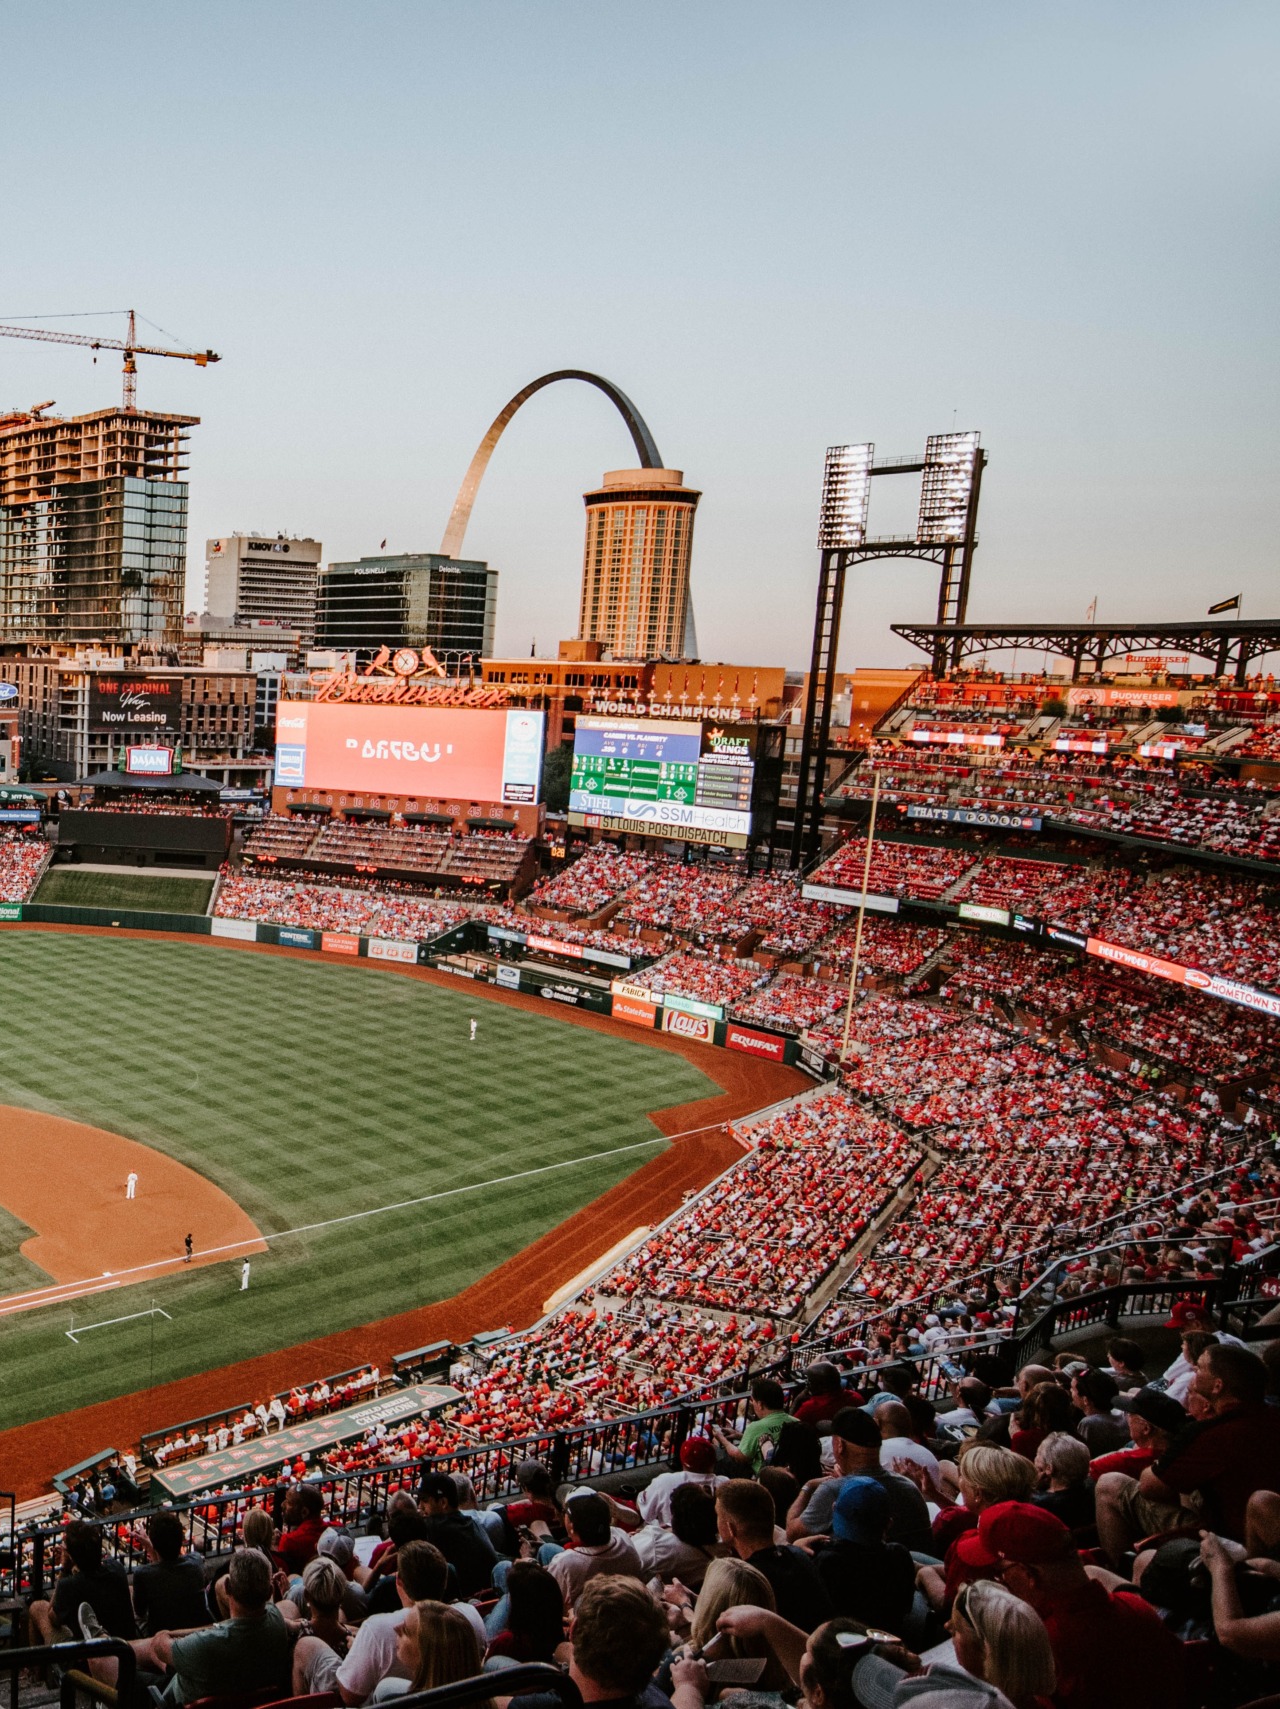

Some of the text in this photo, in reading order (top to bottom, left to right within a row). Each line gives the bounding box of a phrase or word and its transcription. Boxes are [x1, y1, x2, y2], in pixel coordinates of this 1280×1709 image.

[248, 542, 281, 552] KMOV 4
[354, 567, 386, 575] POLSINELLI
[1126, 654, 1189, 663] BUDWEISER
[99, 682, 171, 694] ONE CARDINAL
[308, 671, 509, 706] Budweiser
[119, 689, 151, 710] Way
[1110, 690, 1172, 701] BUDWEISER
[595, 700, 742, 720] WORLD CHAMPIONS
[102, 711, 166, 724] Now Leasing
[710, 736, 750, 746] DRAFT
[714, 745, 748, 754] KINGS
[132, 754, 166, 766] DASANI
[312, 795, 320, 804] 2
[354, 796, 364, 807] 10
[370, 797, 380, 808] 14
[405, 801, 418, 812] 20
[426, 802, 438, 814] 24
[447, 803, 460, 816] 42
[468, 806, 482, 818] 45
[490, 807, 504, 819] 85
[580, 795, 613, 810] STIFEL
[913, 806, 950, 820] THAT'S
[952, 810, 961, 821] A
[602, 818, 616, 829] ST.
[618, 819, 645, 833] LOUIS
[648, 822, 728, 845] POST-DISPATCH
[1098, 944, 1150, 968] HOLLYWOOD
[437, 964, 474, 978] BUSCH STADIUM
[502, 968, 517, 978] Ford
[554, 992, 578, 1004] MIDWEST
[622, 986, 646, 998] FABICK
[1210, 982, 1270, 1010] HOMETOWN
[670, 1010, 708, 1036] Lay's
[730, 1032, 778, 1053] EQUIFAX
[1262, 1282, 1280, 1297] 44
[348, 1406, 382, 1420] WORLD
[355, 1400, 418, 1426] CHAMPIONS
